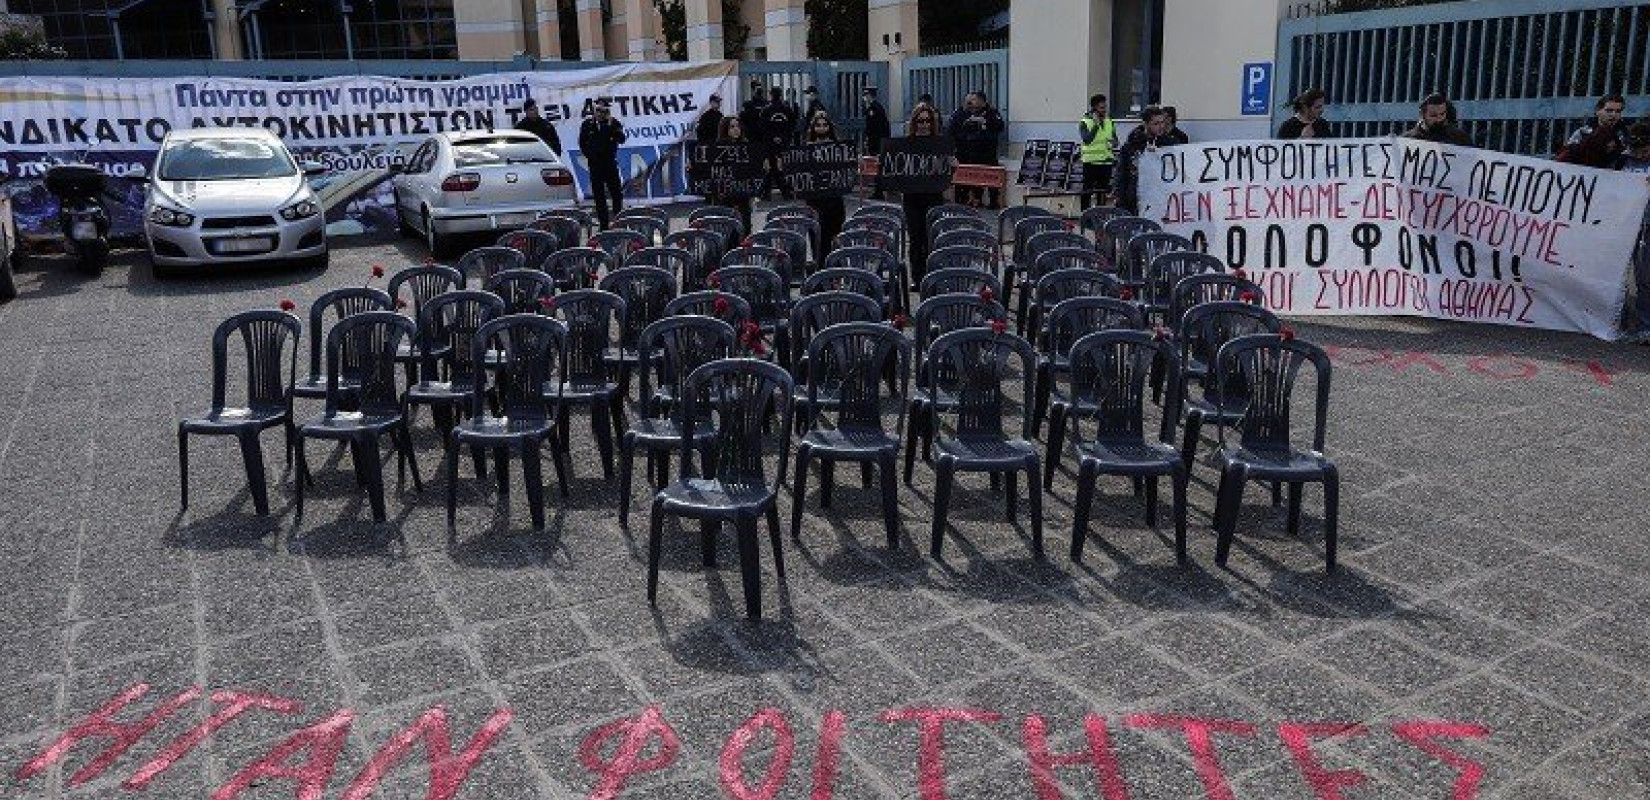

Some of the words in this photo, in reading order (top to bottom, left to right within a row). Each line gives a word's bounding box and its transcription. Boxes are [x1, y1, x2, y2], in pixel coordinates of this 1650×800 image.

[174, 82, 268, 108] Πάντα
[275, 87, 341, 112] στην
[348, 80, 435, 110] πρώτη
[441, 77, 531, 108] γραμμή
[1249, 66, 1265, 95] P
[504, 103, 571, 130] ΤΞΙ
[581, 92, 698, 119] ΑΤΙΚΗΣ
[1160, 152, 1186, 184] ΟΙ
[1198, 142, 1395, 184] ΣΥΜΦΟΙΤΗΤΕΣ
[1399, 145, 1456, 191] ΜΑΣ
[1161, 190, 1213, 224] ΔΕΝ
[1438, 278, 1535, 323] ΑΘΗΝΑΣ
[14, 682, 514, 800] ΗΤΑΝ
[578, 704, 1492, 800] ΦΟΙΤΗΤΕΣ
